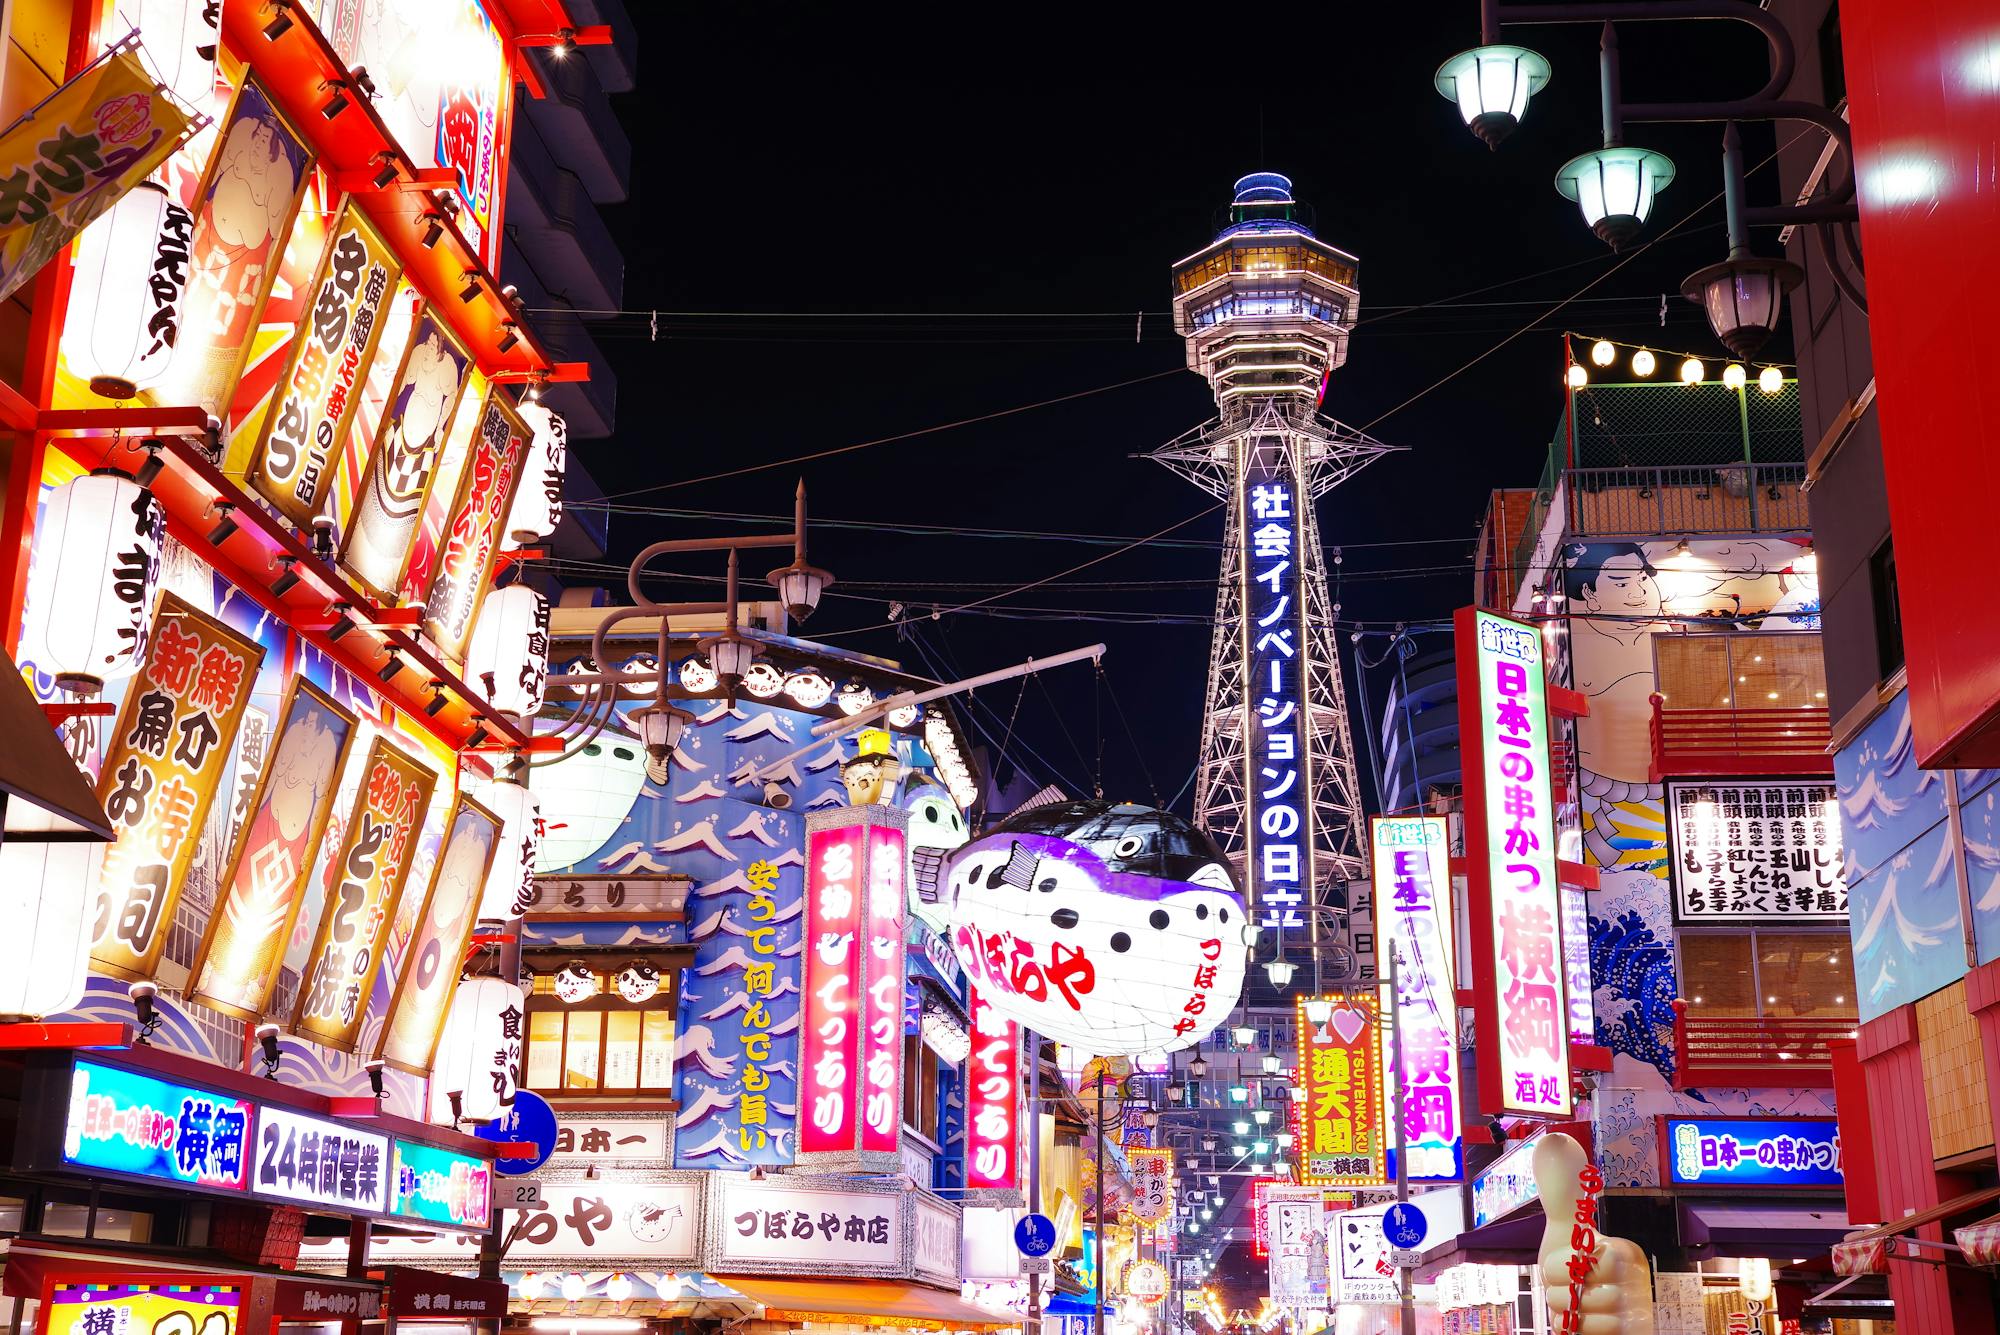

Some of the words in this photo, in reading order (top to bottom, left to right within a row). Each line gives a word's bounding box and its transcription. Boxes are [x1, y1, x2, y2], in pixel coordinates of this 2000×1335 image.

[270, 233, 366, 480] 名物串かつ
[427, 445, 495, 626] ちゃんこ鍋
[152, 622, 243, 715] 新鮮
[1481, 619, 1537, 660] 新世界
[129, 692, 219, 770] 魚介
[1252, 485, 1303, 928] 社会イノベーションの日立
[370, 766, 400, 815] 名物
[1496, 662, 1540, 892] 日本一の串かつ
[1722, 789, 1742, 818] 前頭
[1743, 788, 1763, 818] 前頭
[1765, 788, 1785, 818] 前頭
[1786, 788, 1806, 818] 前頭
[1807, 788, 1827, 818] 前頭
[342, 785, 419, 1023] 大阪下町の味
[820, 843, 853, 920] 名物
[1684, 849, 1705, 912] もち
[1727, 849, 1750, 912] 紅しょうが
[1748, 850, 1770, 912] にんにく
[1770, 850, 1793, 912] 玉ねぎ
[1791, 849, 1814, 912] 山芋
[1814, 849, 1837, 912] しし唐
[955, 923, 1095, 1011] づぼらや
[1499, 898, 1560, 1062] 横綱
[740, 859, 780, 1151] 安うて何んでも旨い
[814, 975, 849, 1135] てっちり
[867, 975, 897, 1135] てっちり
[1312, 1048, 1352, 1154] 通天閣
[1353, 1048, 1368, 1153] TSUTENKAKU
[1515, 1072, 1561, 1106] 酒処
[84, 1095, 174, 1149] 日本一の串かつ
[176, 1100, 244, 1178] 横綱
[260, 1122, 379, 1203] 24時間営業
[556, 1128, 647, 1153] 日本一
[1333, 1158, 1370, 1176] 横綱
[1700, 1137, 1834, 1170] 日本一の串かつ
[1147, 1158, 1166, 1206] 串かつ
[734, 1209, 890, 1244] づぼらや本店
[414, 1294, 450, 1310] 横綱
